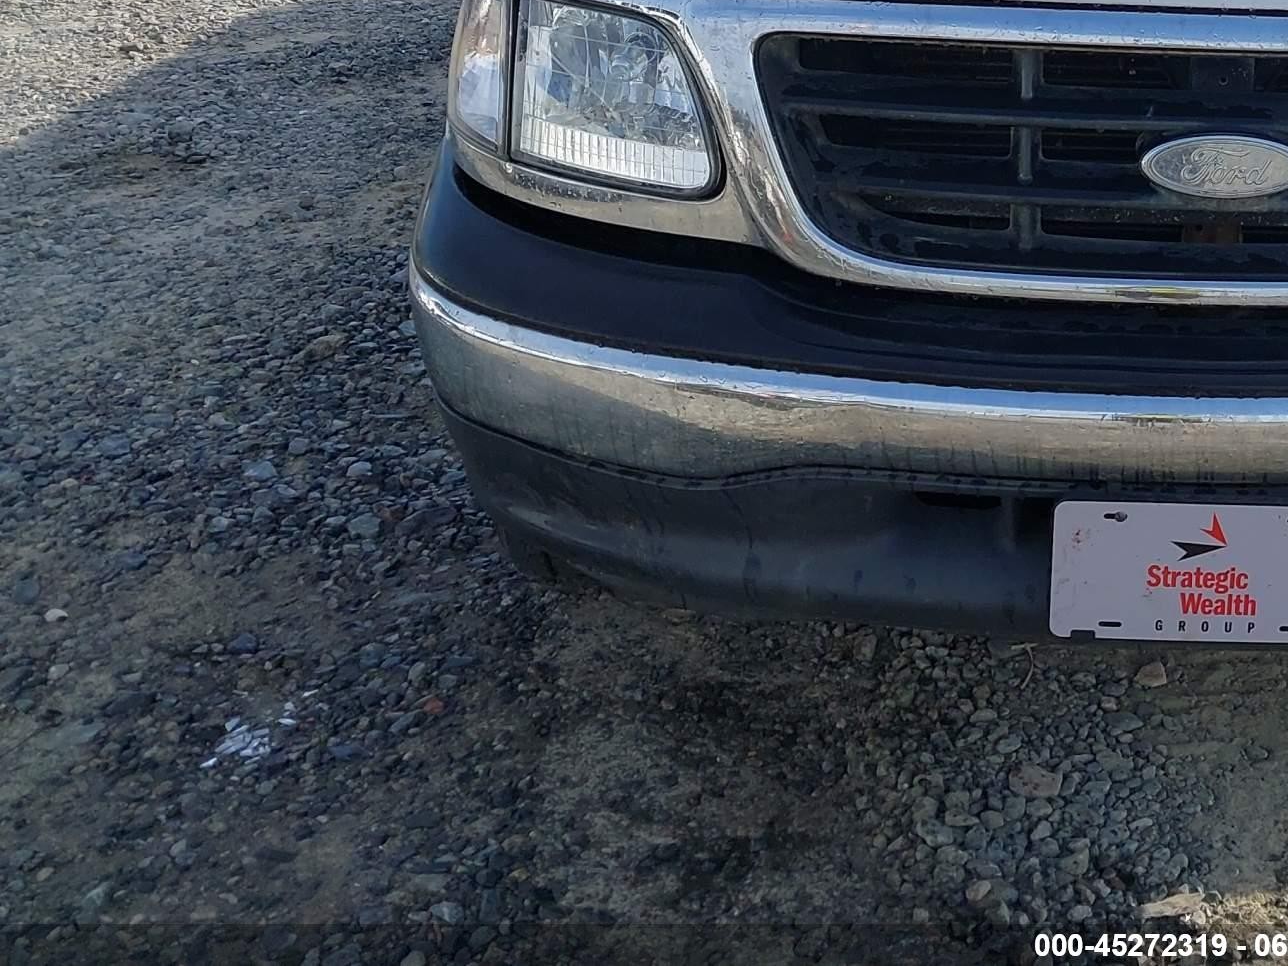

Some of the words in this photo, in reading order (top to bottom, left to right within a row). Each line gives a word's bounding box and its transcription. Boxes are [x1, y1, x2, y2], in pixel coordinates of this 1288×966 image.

[1181, 146, 1272, 186] Ford
[1146, 564, 1249, 594] Strategic
[1180, 592, 1257, 617] Wealth
[1154, 619, 1256, 634] GROUP
